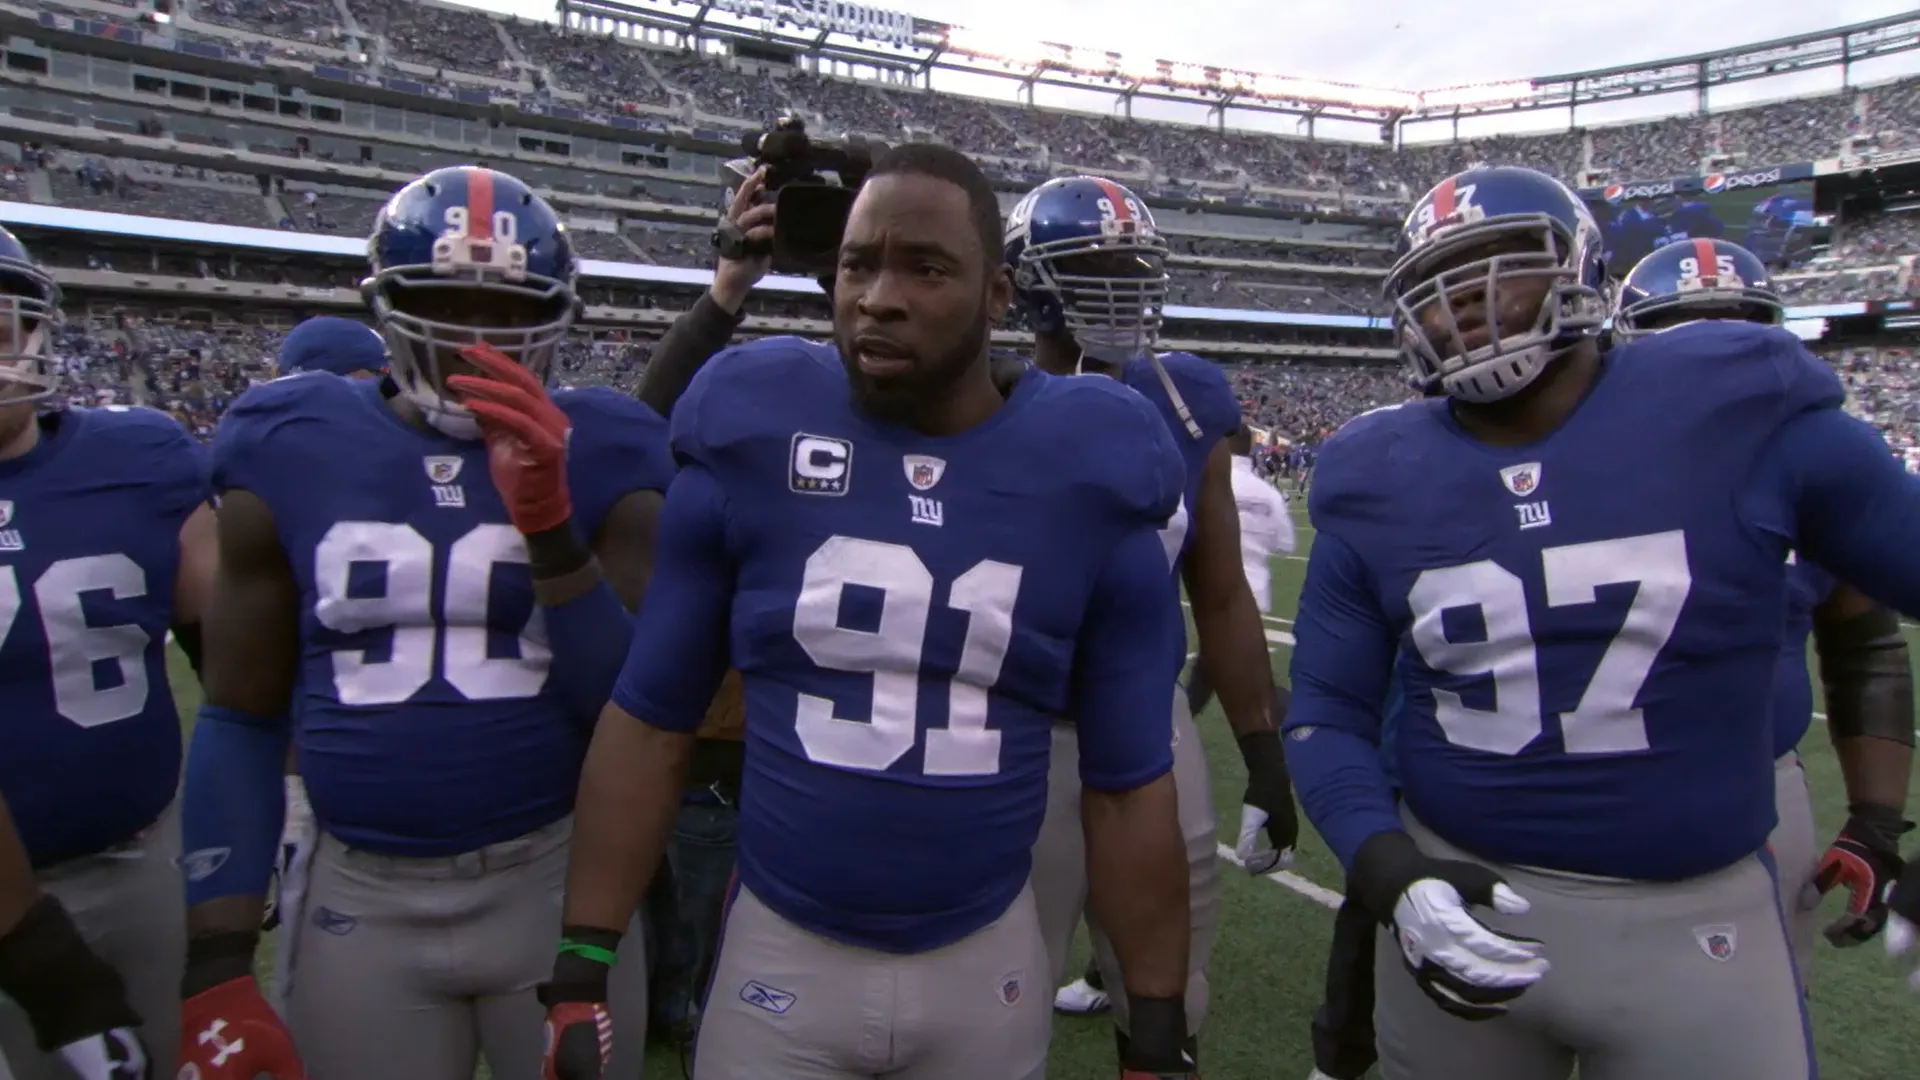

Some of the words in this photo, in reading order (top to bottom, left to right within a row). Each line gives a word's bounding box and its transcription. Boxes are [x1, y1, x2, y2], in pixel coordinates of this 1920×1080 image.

[444, 206, 517, 244] 90
[1097, 197, 1141, 223] 99
[1679, 255, 1735, 278] 95
[796, 438, 847, 479] C
[0, 553, 150, 729] 6
[315, 521, 553, 705] 90
[793, 535, 1024, 776] 91
[1407, 529, 1692, 755] 97
